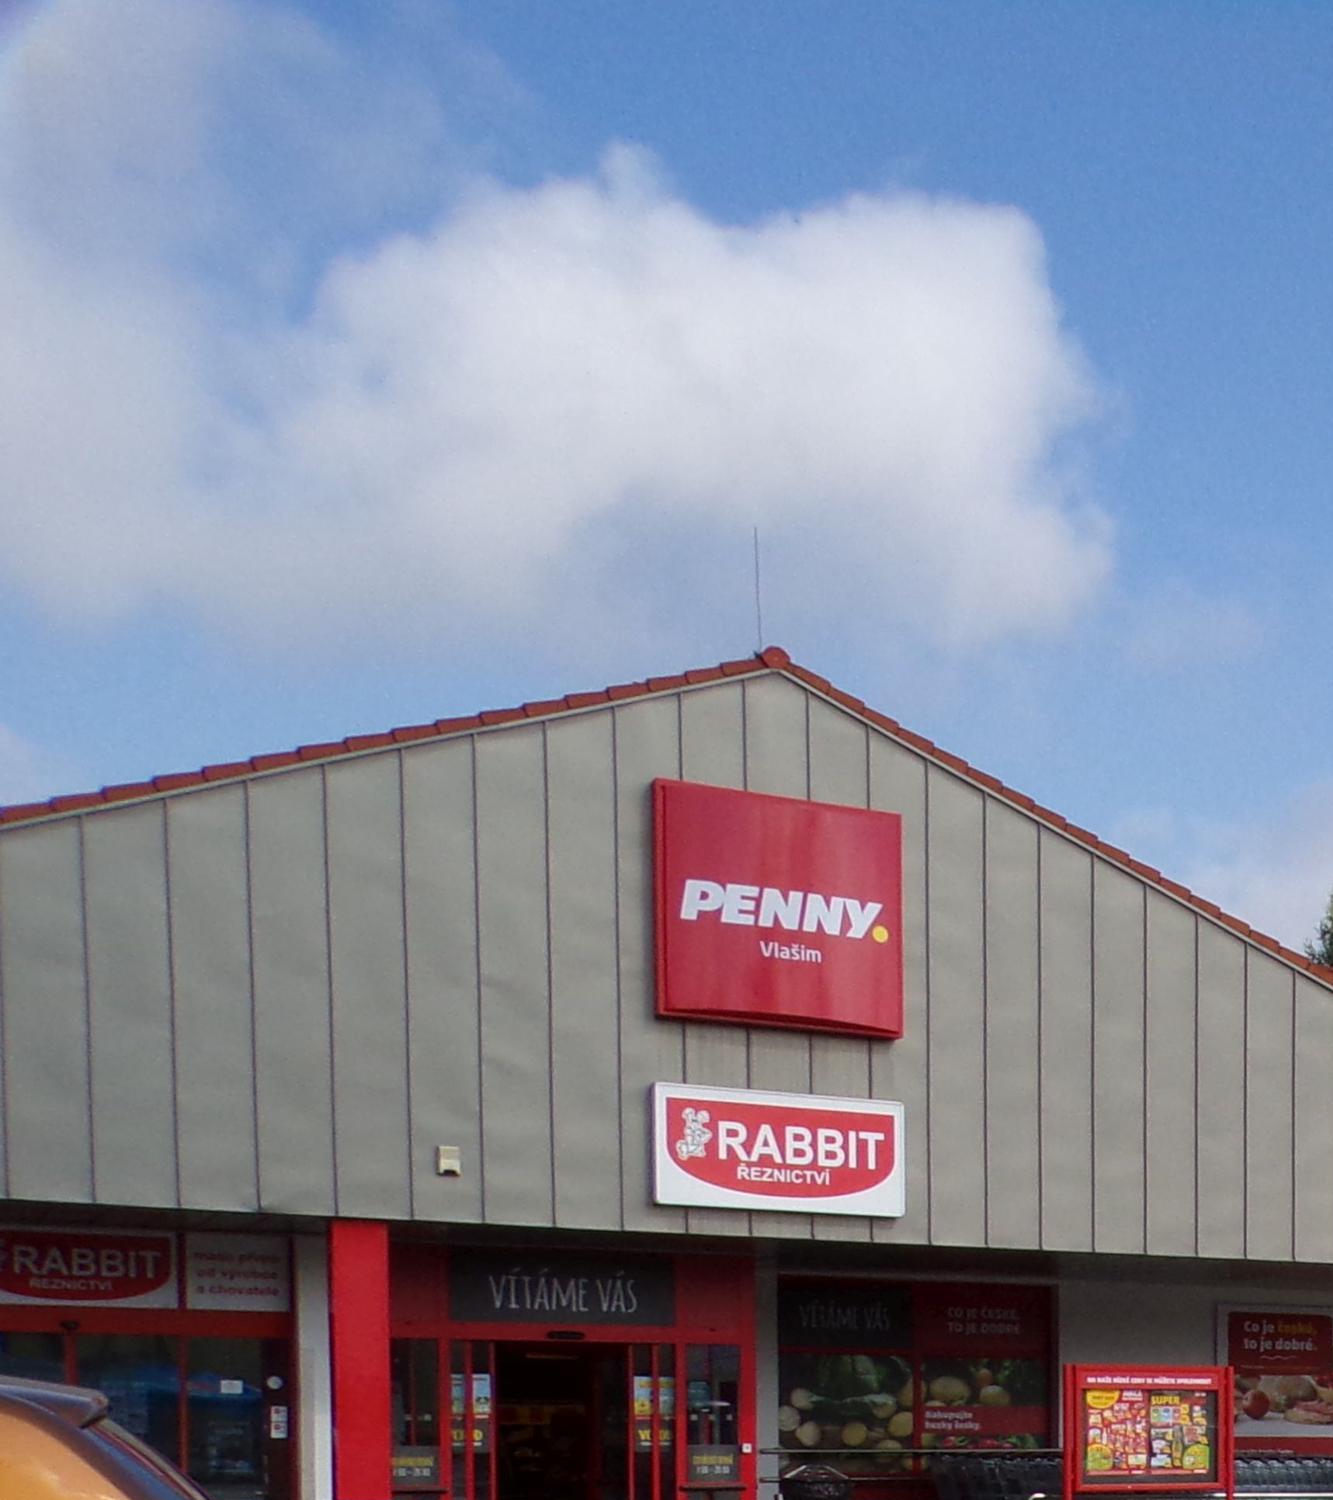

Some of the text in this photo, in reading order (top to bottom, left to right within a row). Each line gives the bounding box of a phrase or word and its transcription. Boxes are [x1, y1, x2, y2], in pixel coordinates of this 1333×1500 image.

[760, 940, 822, 963] Vlašim
[718, 1121, 885, 1170] RABBIT
[737, 1162, 831, 1186] ŘEZNICTVÍ
[13, 1244, 161, 1279] RABBIT
[489, 1268, 638, 1313] VÍTÁME VÁS
[1243, 1320, 1260, 1332] Co
[1262, 1319, 1275, 1335] je
[1243, 1338, 1258, 1350] to
[1260, 1337, 1273, 1352] je
